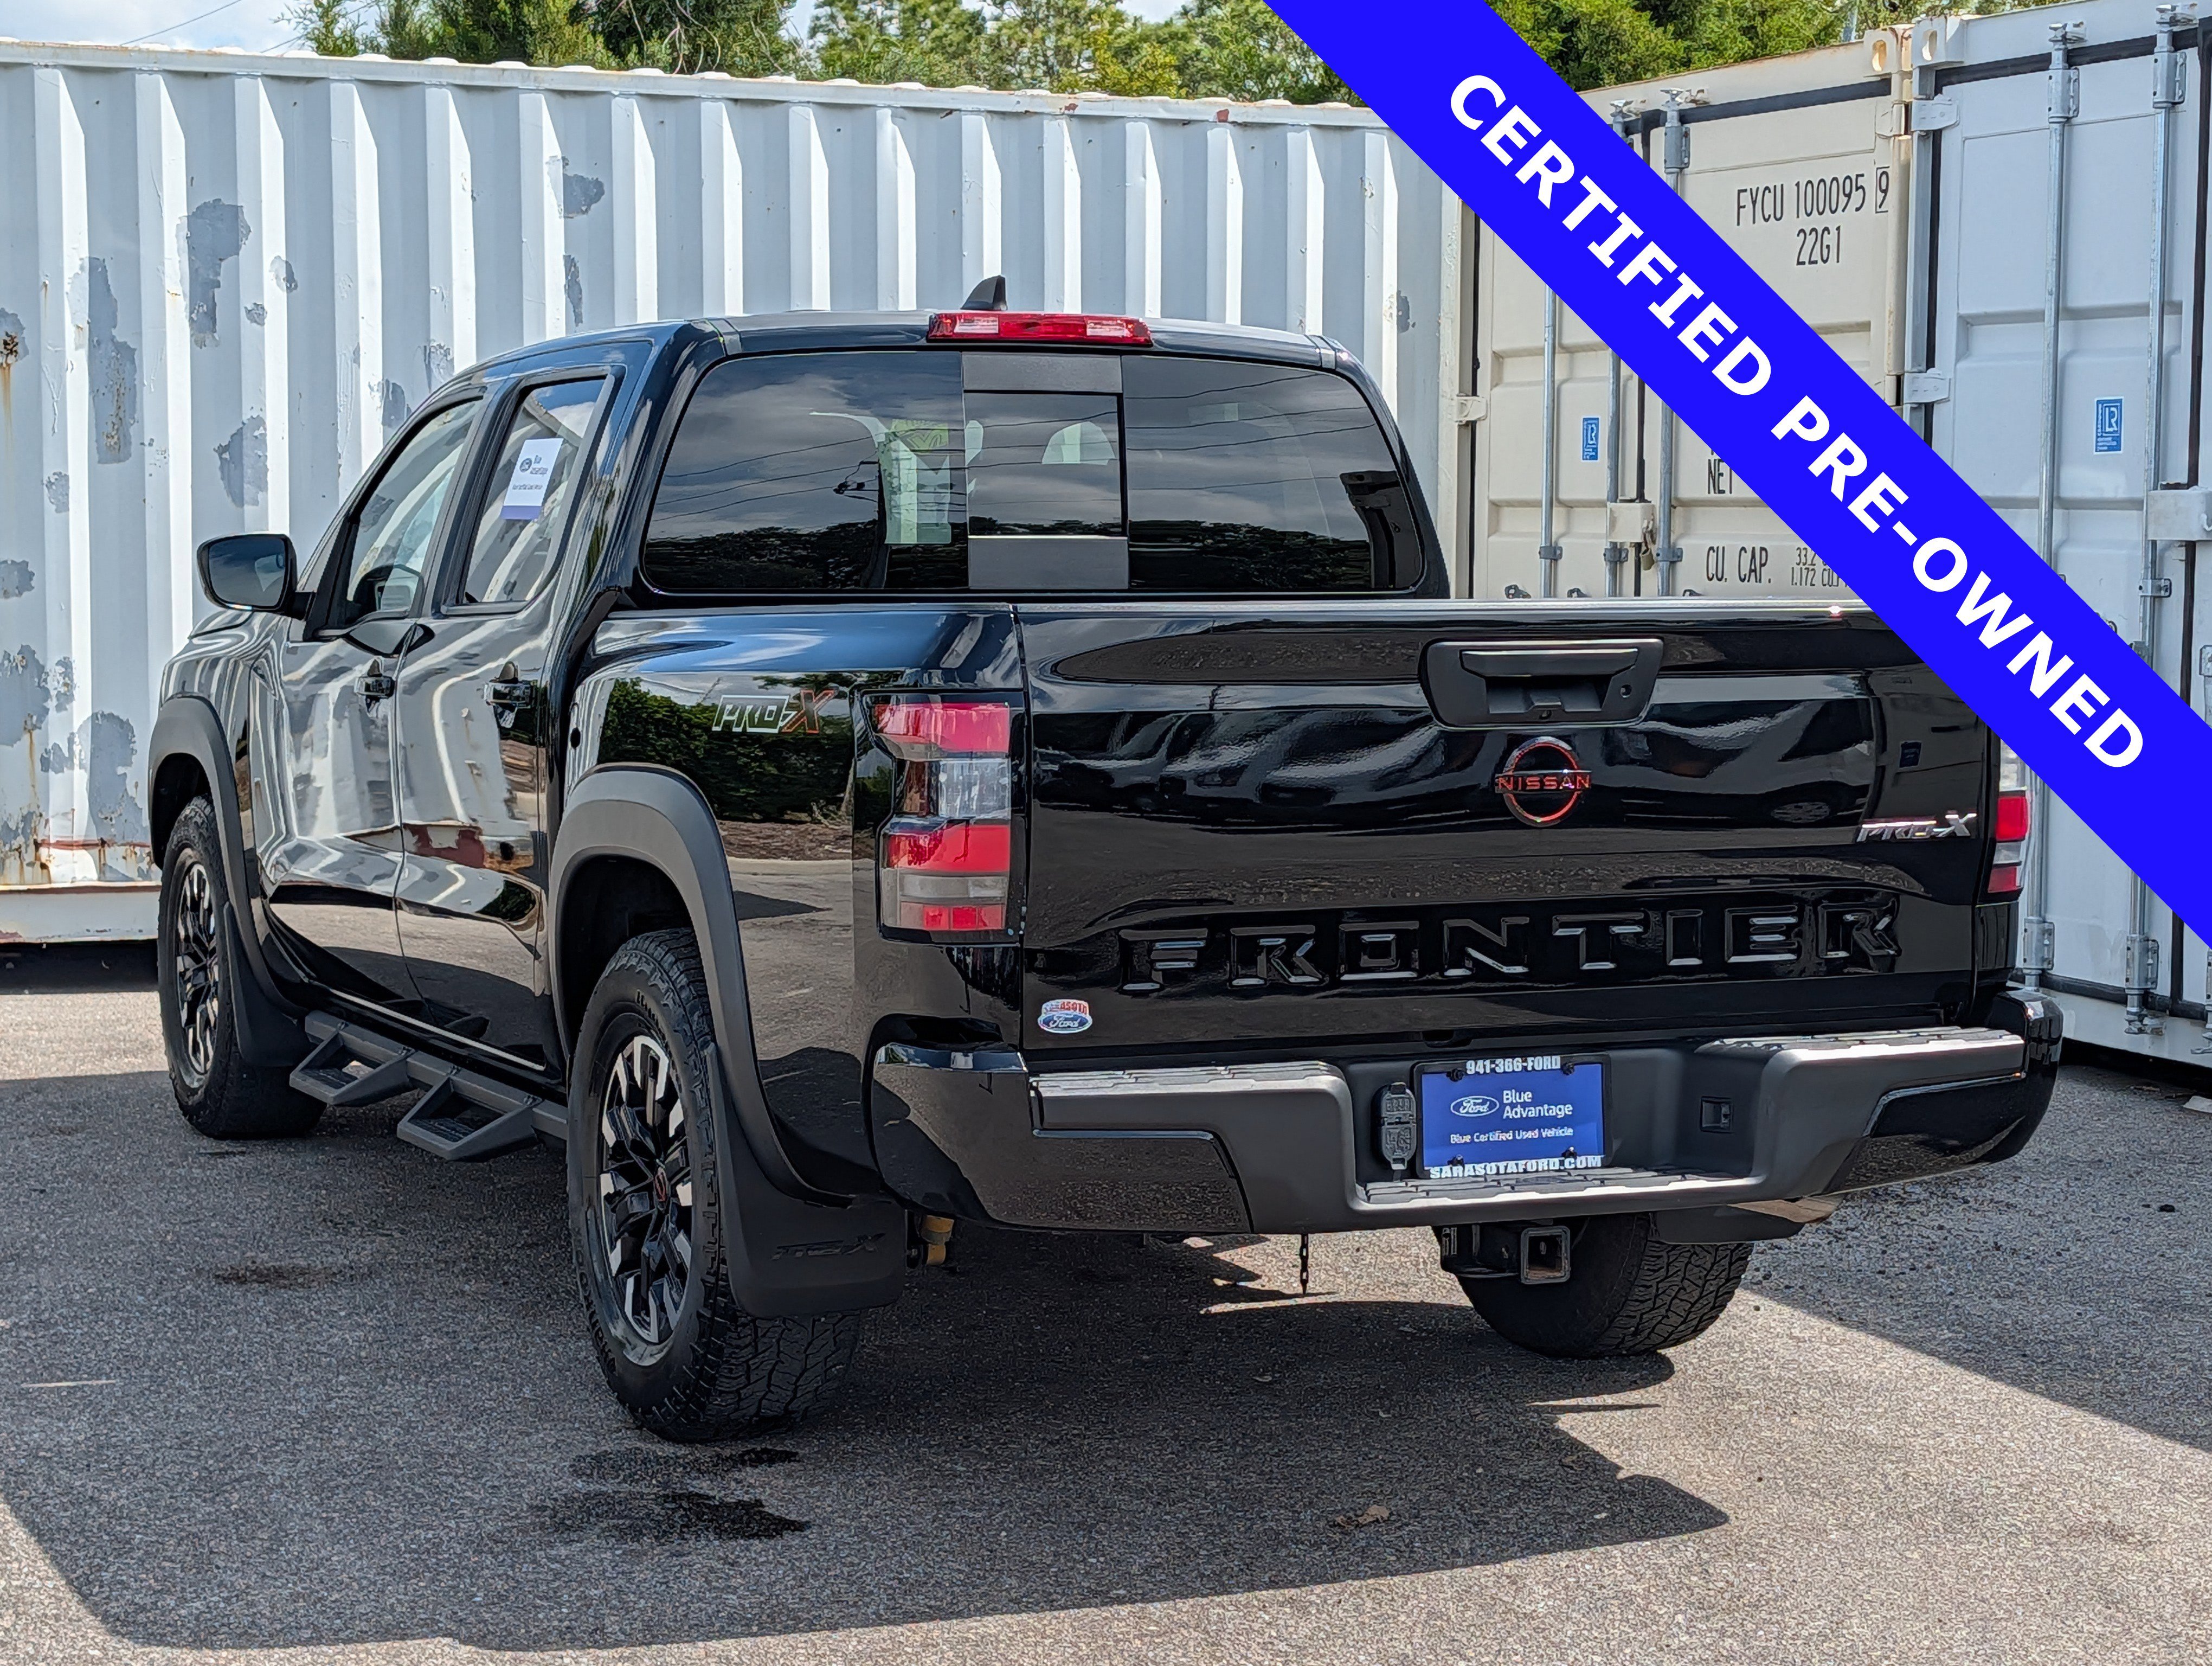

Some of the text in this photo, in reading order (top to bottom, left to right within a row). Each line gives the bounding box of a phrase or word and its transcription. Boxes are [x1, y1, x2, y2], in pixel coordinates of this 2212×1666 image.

[1736, 170, 1890, 227] FYCU 100095 9
[1796, 225, 1841, 266] 22G1
[1737, 546, 1772, 584] CAP.
[1497, 774, 1590, 792] NISSAN
[1118, 899, 1901, 991] FRONTIER
[1049, 1014, 1082, 1028] Ford
[1465, 1055, 1561, 1075] 941-366-FORD
[1502, 1089, 1533, 1104] Blue
[1458, 1098, 1573, 1119] Ford Advantage
[1450, 1126, 1574, 1144] Blue Certified Used Vehicle
[1430, 1155, 1604, 1179] SARASOTAFORD.COM
